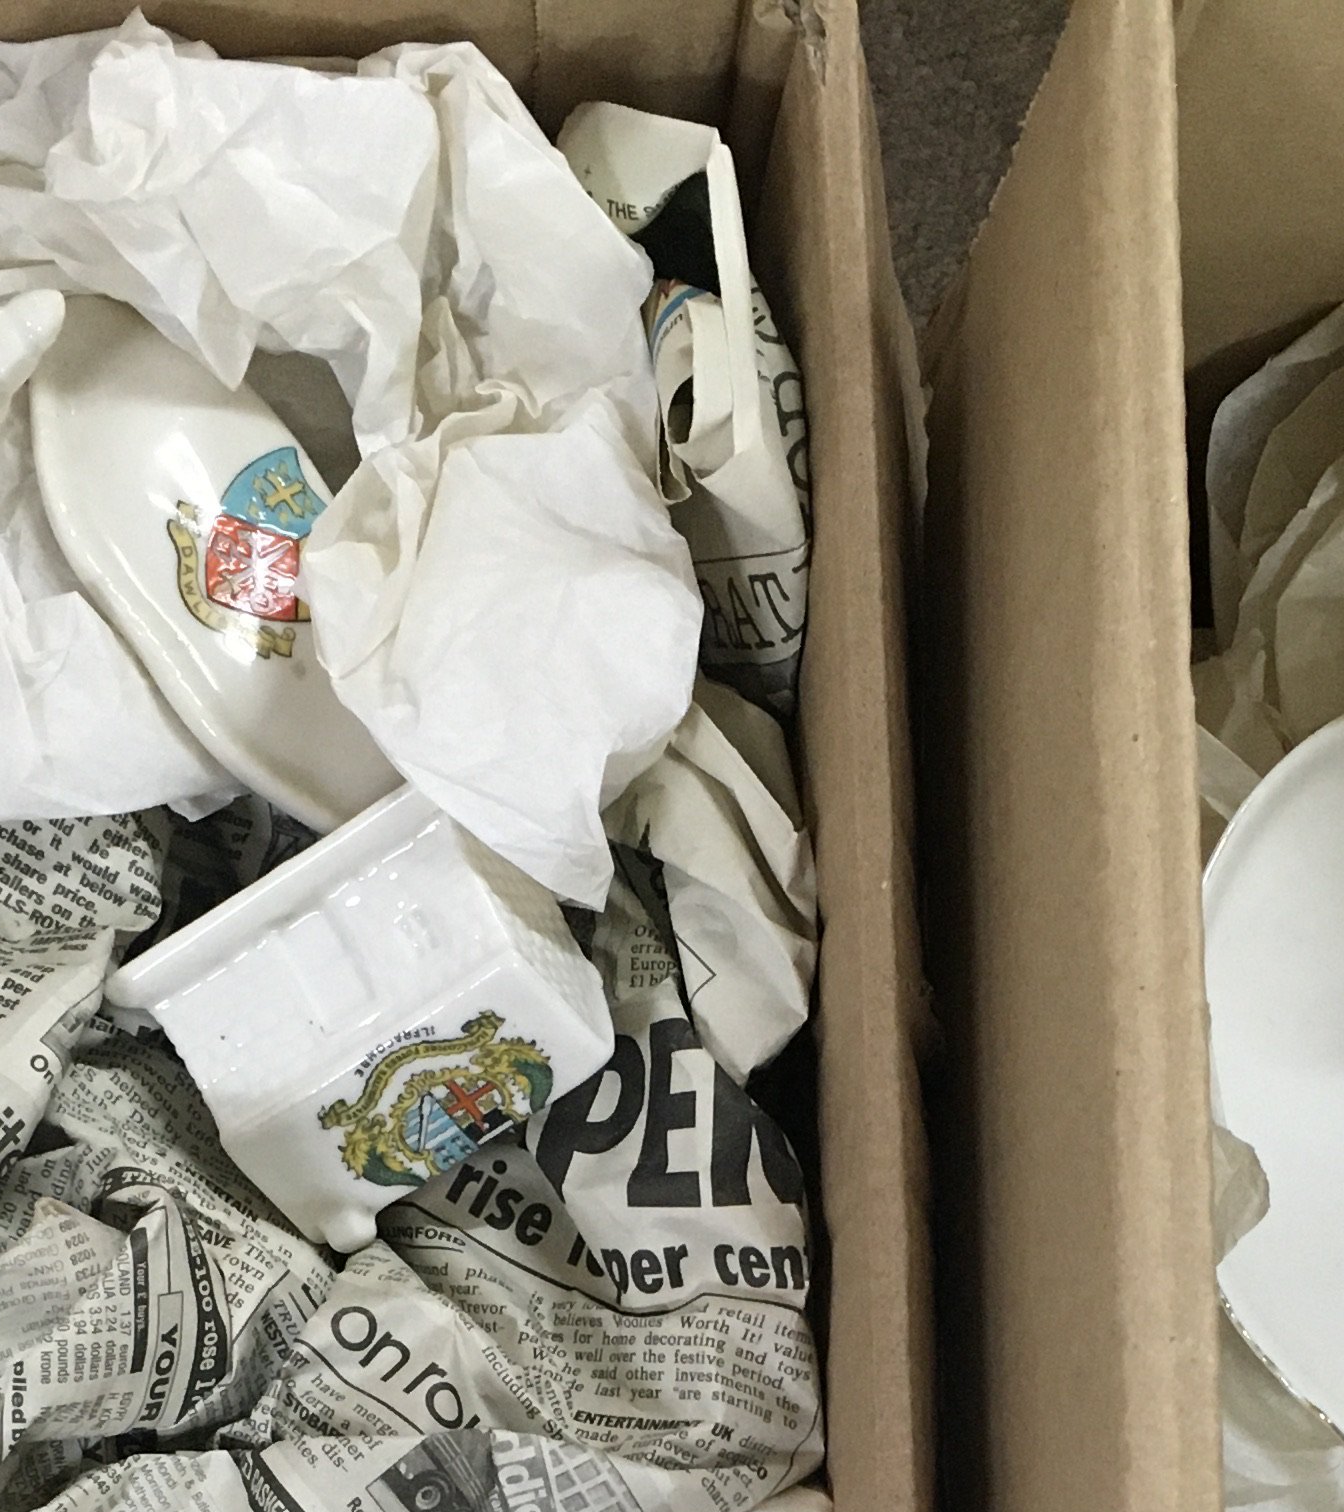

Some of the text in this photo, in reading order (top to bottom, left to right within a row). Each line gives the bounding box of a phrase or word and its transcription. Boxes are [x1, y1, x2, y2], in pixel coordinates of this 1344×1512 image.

[23, 820, 120, 884] or it would
[90, 839, 108, 859] be
[102, 829, 148, 860] either
[2, 853, 97, 914] share price.
[54, 862, 126, 908] at below
[52, 904, 72, 920] on
[1, 977, 31, 997] per
[354, 1025, 436, 1078] ILFRACOMBE
[109, 1071, 158, 1118] helped
[446, 1159, 554, 1246] rise
[136, 1262, 146, 1288] Your
[245, 1244, 274, 1269] The
[601, 1244, 687, 1295] per
[228, 1271, 255, 1293] the
[461, 1302, 507, 1315] Trevor
[553, 1313, 730, 1334] believes Worth
[718, 1306, 766, 1329] retail
[56, 1340, 69, 1383] pounds
[74, 1344, 85, 1382] dollars
[89, 1342, 101, 1380] dollars
[104, 1340, 117, 1378] dollars
[118, 1344, 129, 1375] euros
[202, 1321, 219, 1371] rose
[573, 1332, 811, 1382] for home decorating and toys
[575, 1350, 602, 1362] well
[609, 1351, 636, 1362] over
[643, 1350, 666, 1363] the
[674, 1350, 724, 1368] festive
[40, 1351, 53, 1384] krone
[139, 1323, 179, 1422] YOUR
[482, 1345, 540, 1419] including
[311, 1374, 346, 1401] have
[591, 1368, 800, 1414] said other investments the
[594, 1384, 797, 1429] last year starting to
[711, 1422, 735, 1442] UK
